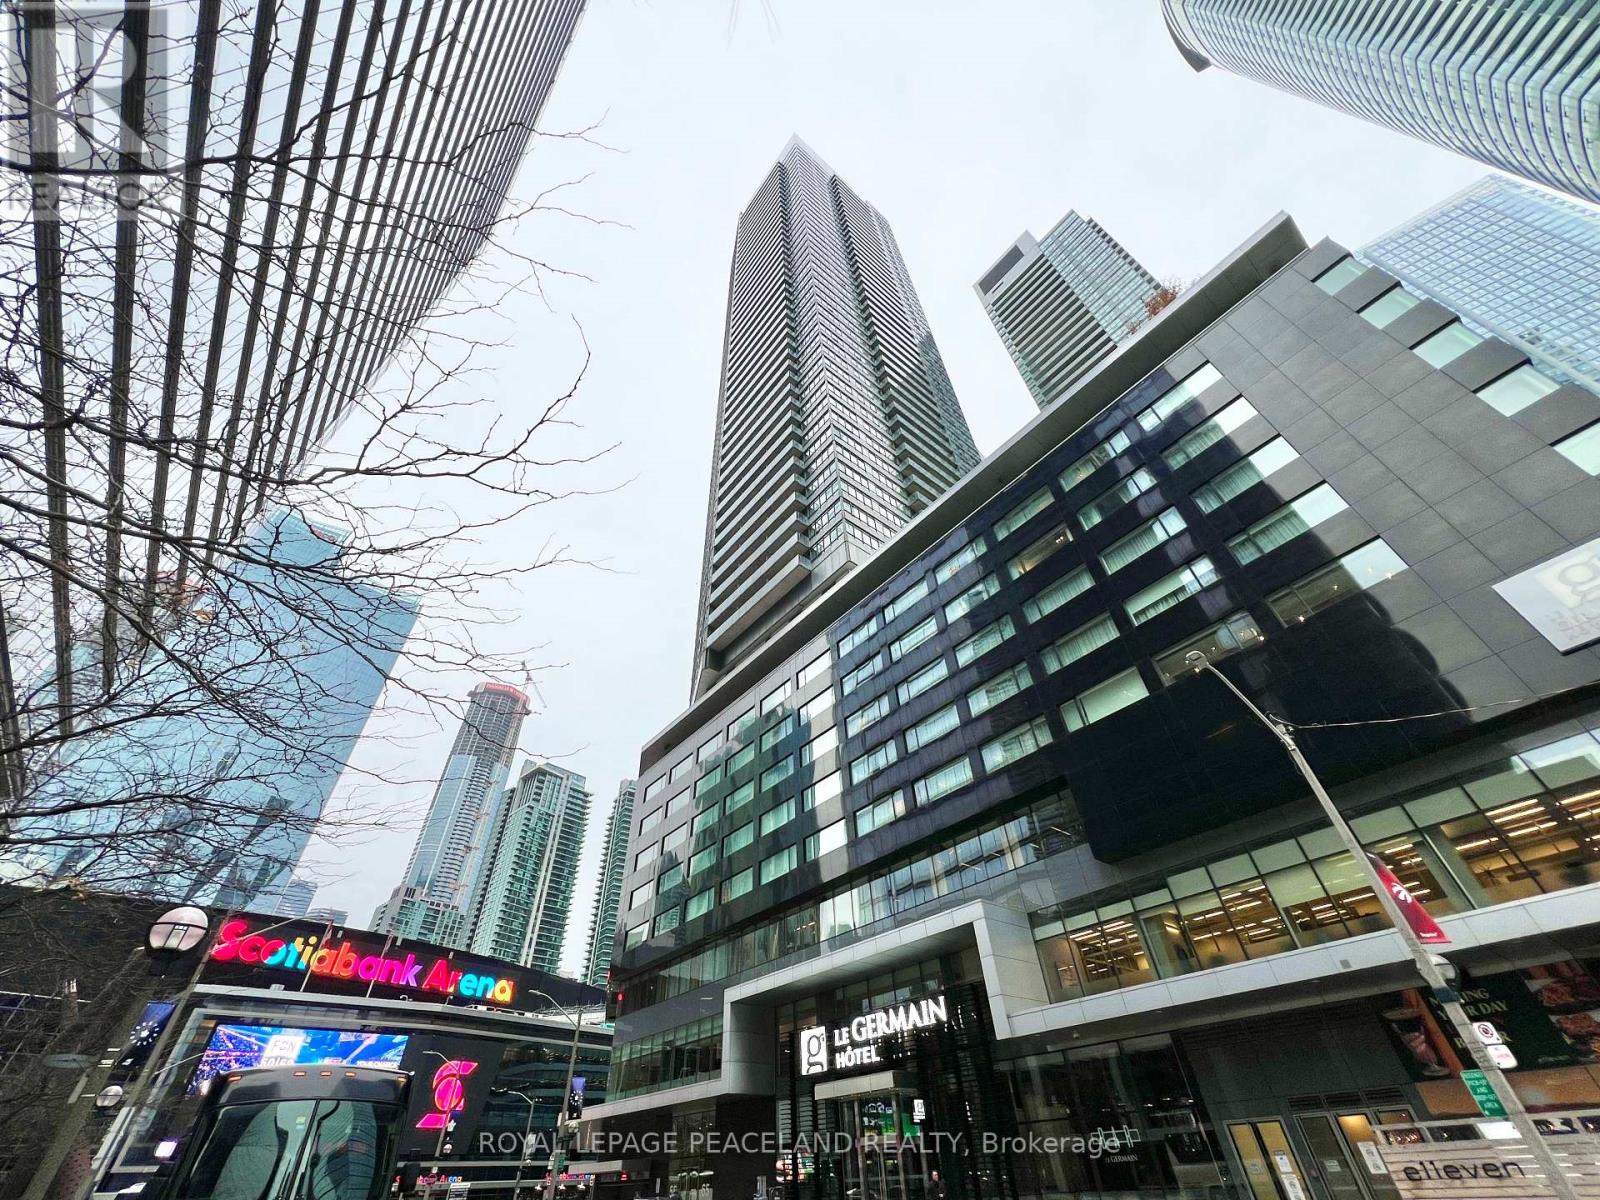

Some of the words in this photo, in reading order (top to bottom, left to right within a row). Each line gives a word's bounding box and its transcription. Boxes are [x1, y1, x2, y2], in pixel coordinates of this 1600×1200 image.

[210, 919, 423, 987] Scotiabank
[422, 958, 515, 1004] Arena
[834, 1027, 850, 1047] LE
[851, 996, 948, 1042] GERMAIN
[836, 1045, 882, 1069] HÔTEL
